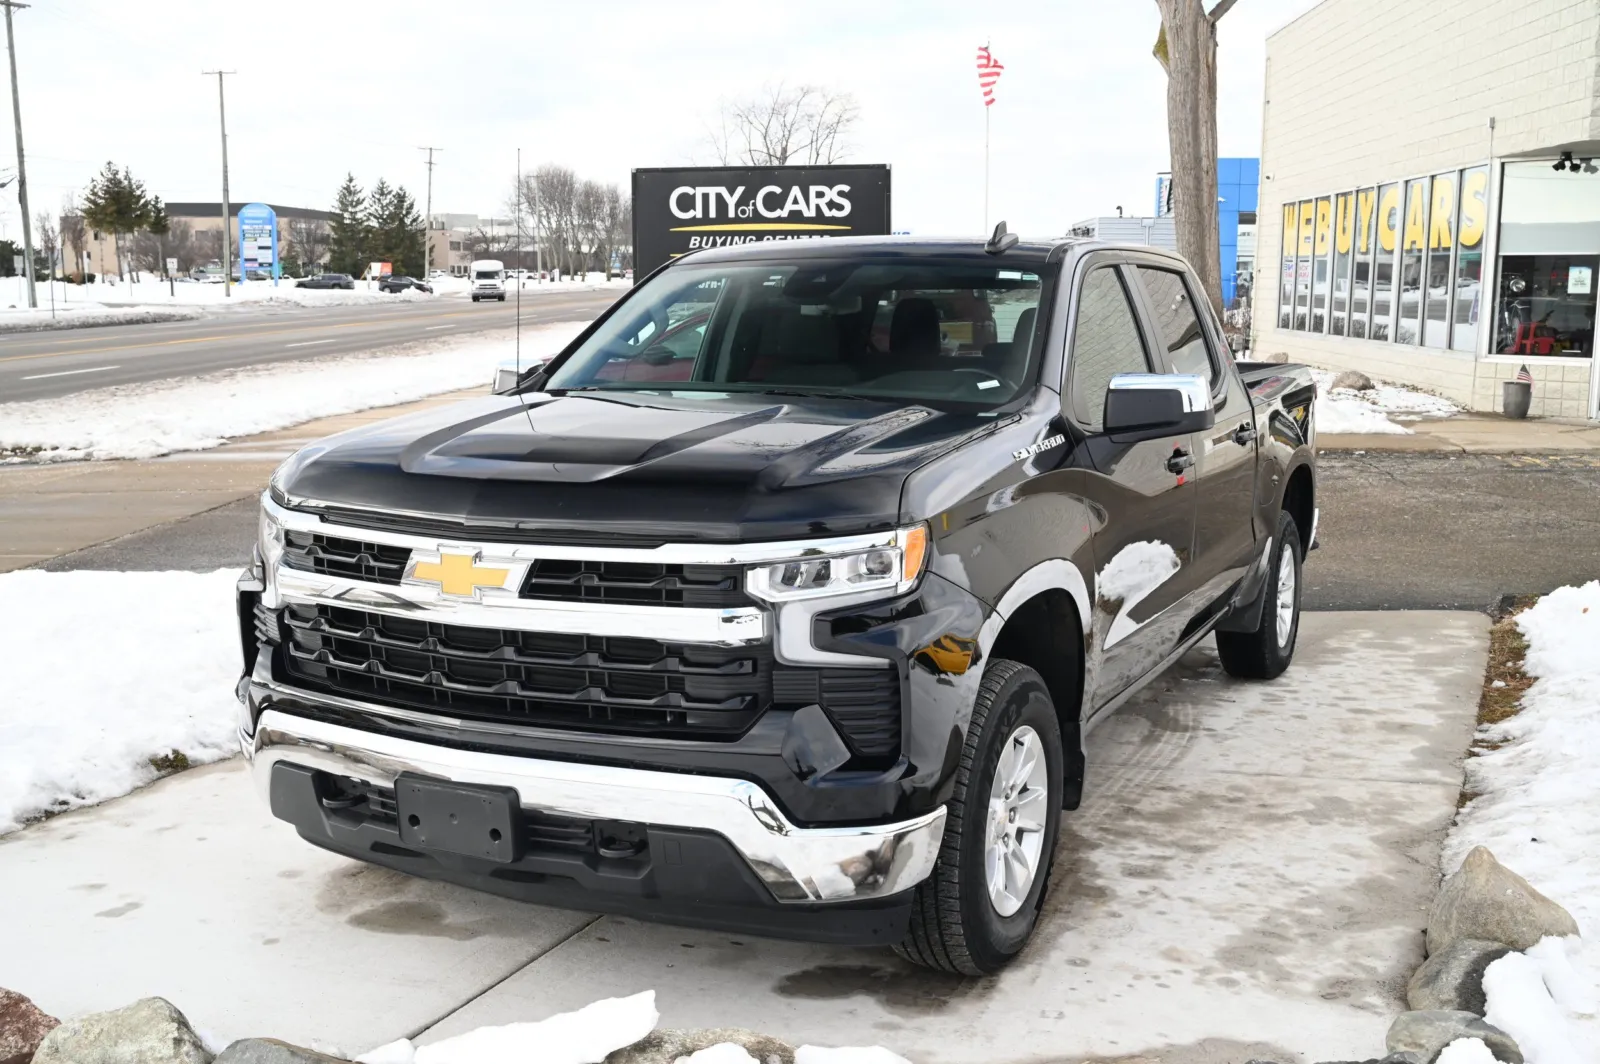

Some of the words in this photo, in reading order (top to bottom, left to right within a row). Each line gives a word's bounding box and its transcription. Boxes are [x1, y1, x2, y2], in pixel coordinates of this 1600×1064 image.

[669, 185, 745, 219] CITY
[737, 200, 755, 218] of
[756, 184, 852, 218] CARS
